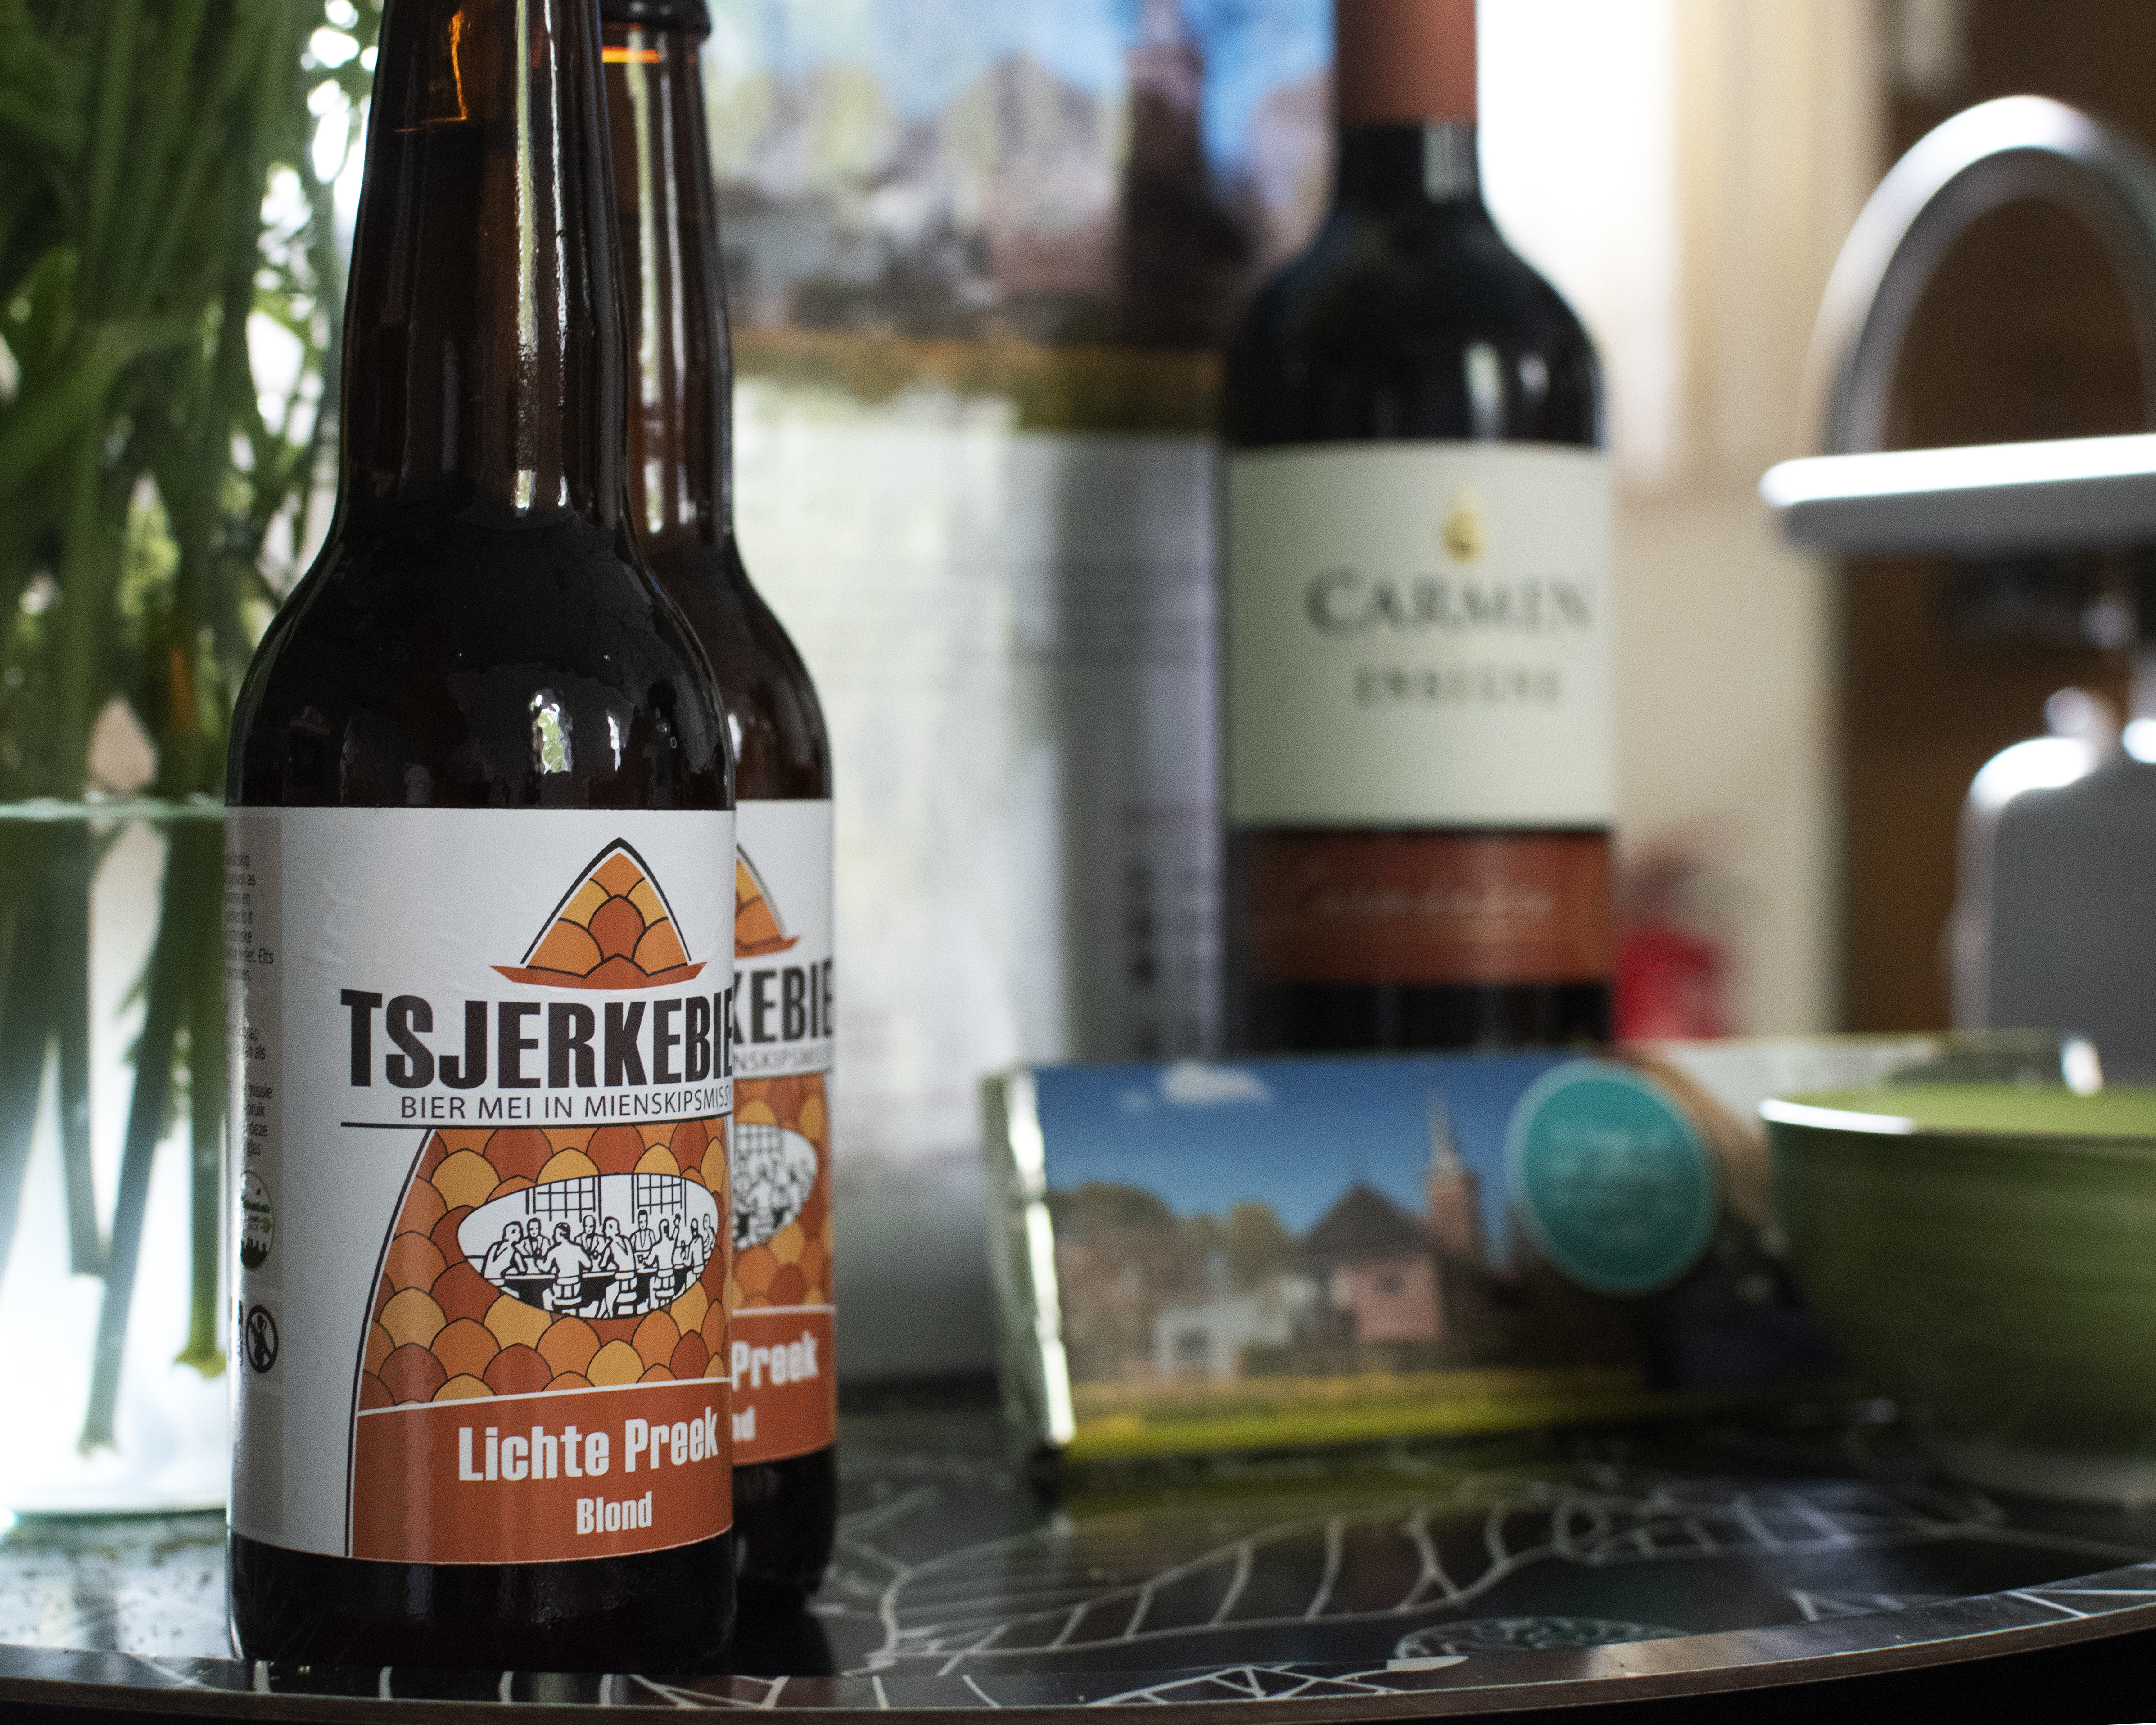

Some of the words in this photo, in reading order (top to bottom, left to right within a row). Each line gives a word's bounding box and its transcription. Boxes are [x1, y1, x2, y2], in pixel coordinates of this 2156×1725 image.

[401, 1096, 466, 1119] BIER
[478, 1097, 531, 1119] MEI
[544, 1097, 572, 1118] IN
[732, 1331, 818, 1391] Preek
[458, 1425, 610, 1481] Lichte
[625, 1406, 718, 1472] Preek
[576, 1491, 652, 1535] Blond
